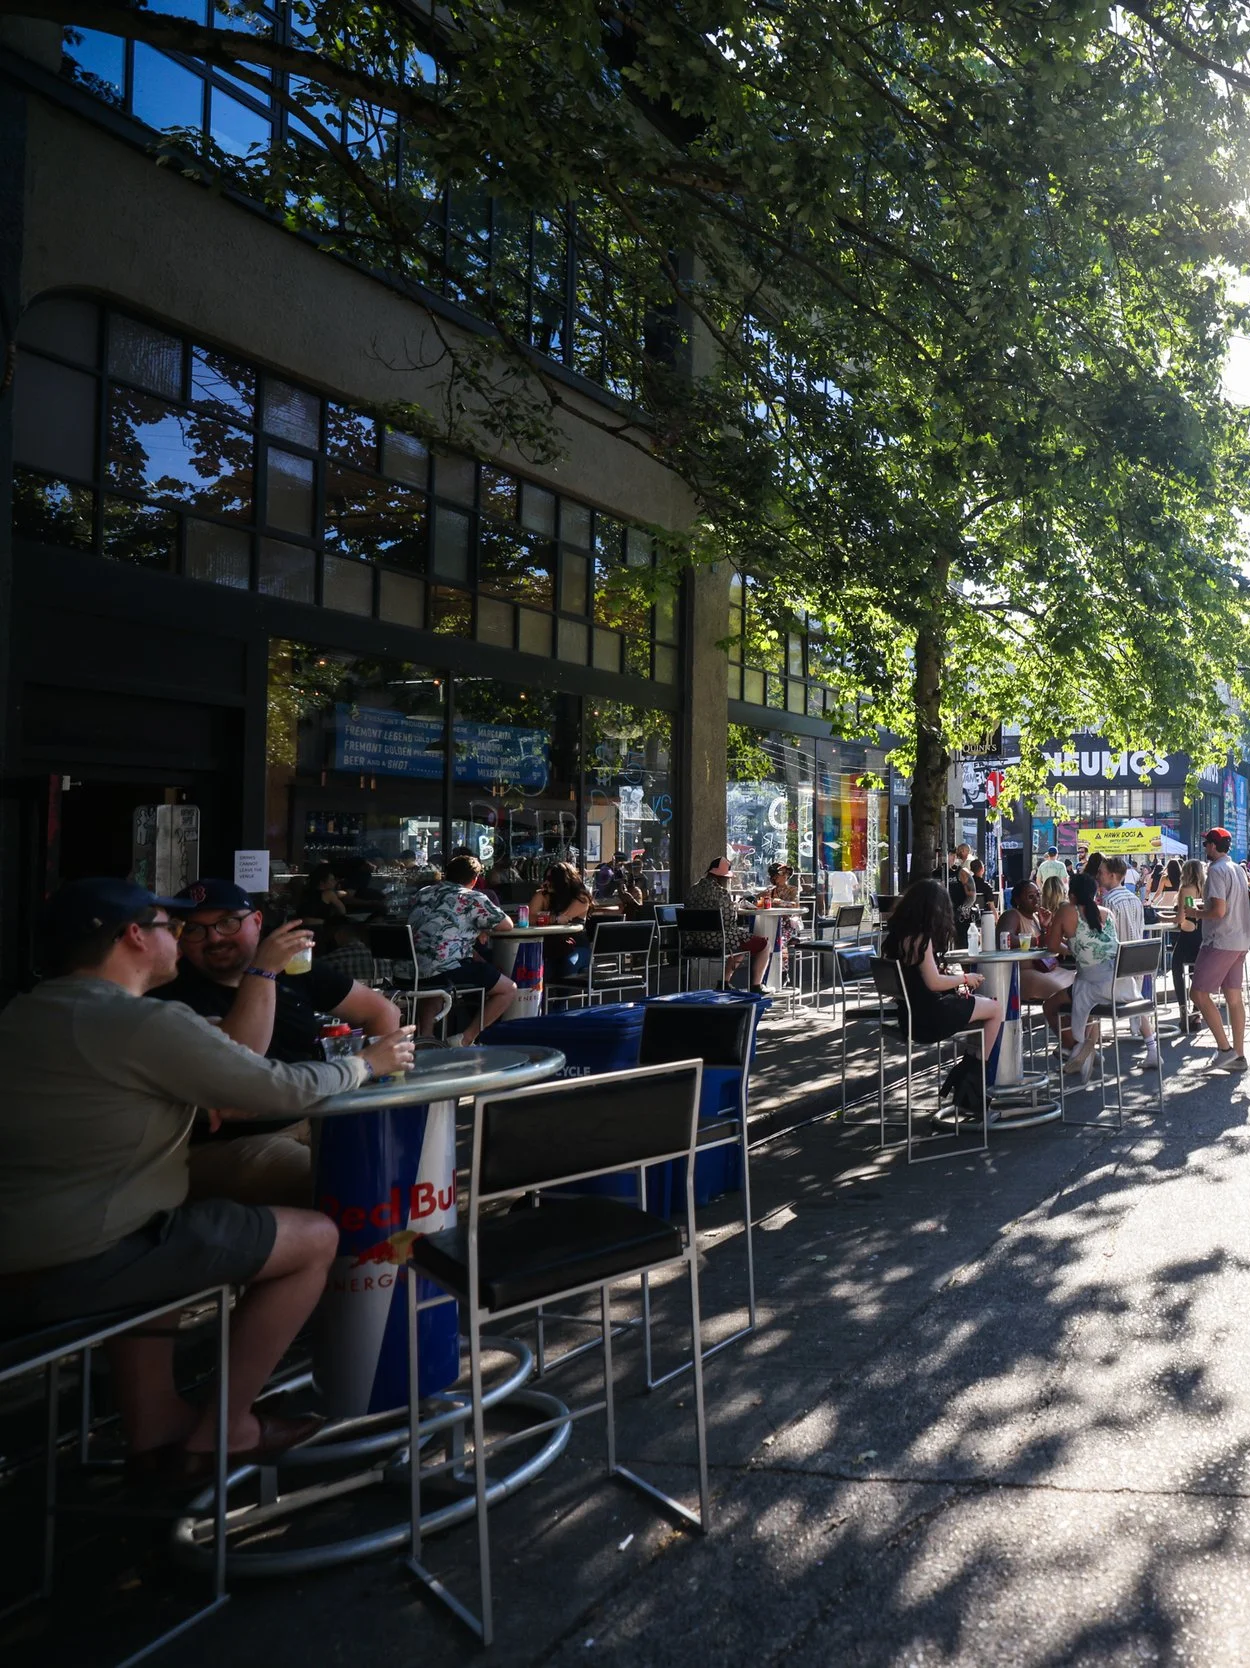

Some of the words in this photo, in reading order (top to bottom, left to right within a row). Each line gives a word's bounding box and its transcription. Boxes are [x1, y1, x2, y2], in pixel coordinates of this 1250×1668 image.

[345, 724, 383, 738] FREMONT
[383, 730, 413, 742] LEGEND
[344, 740, 382, 753] FREMONT
[384, 744, 412, 757] GOLDEN
[343, 755, 365, 766] BEER
[387, 759, 409, 770] SHOT
[1042, 750, 1170, 777] NEUMOS
[555, 1065, 592, 1078] YCLE
[409, 1168, 457, 1221] Bul
[324, 1268, 406, 1294] NERG
